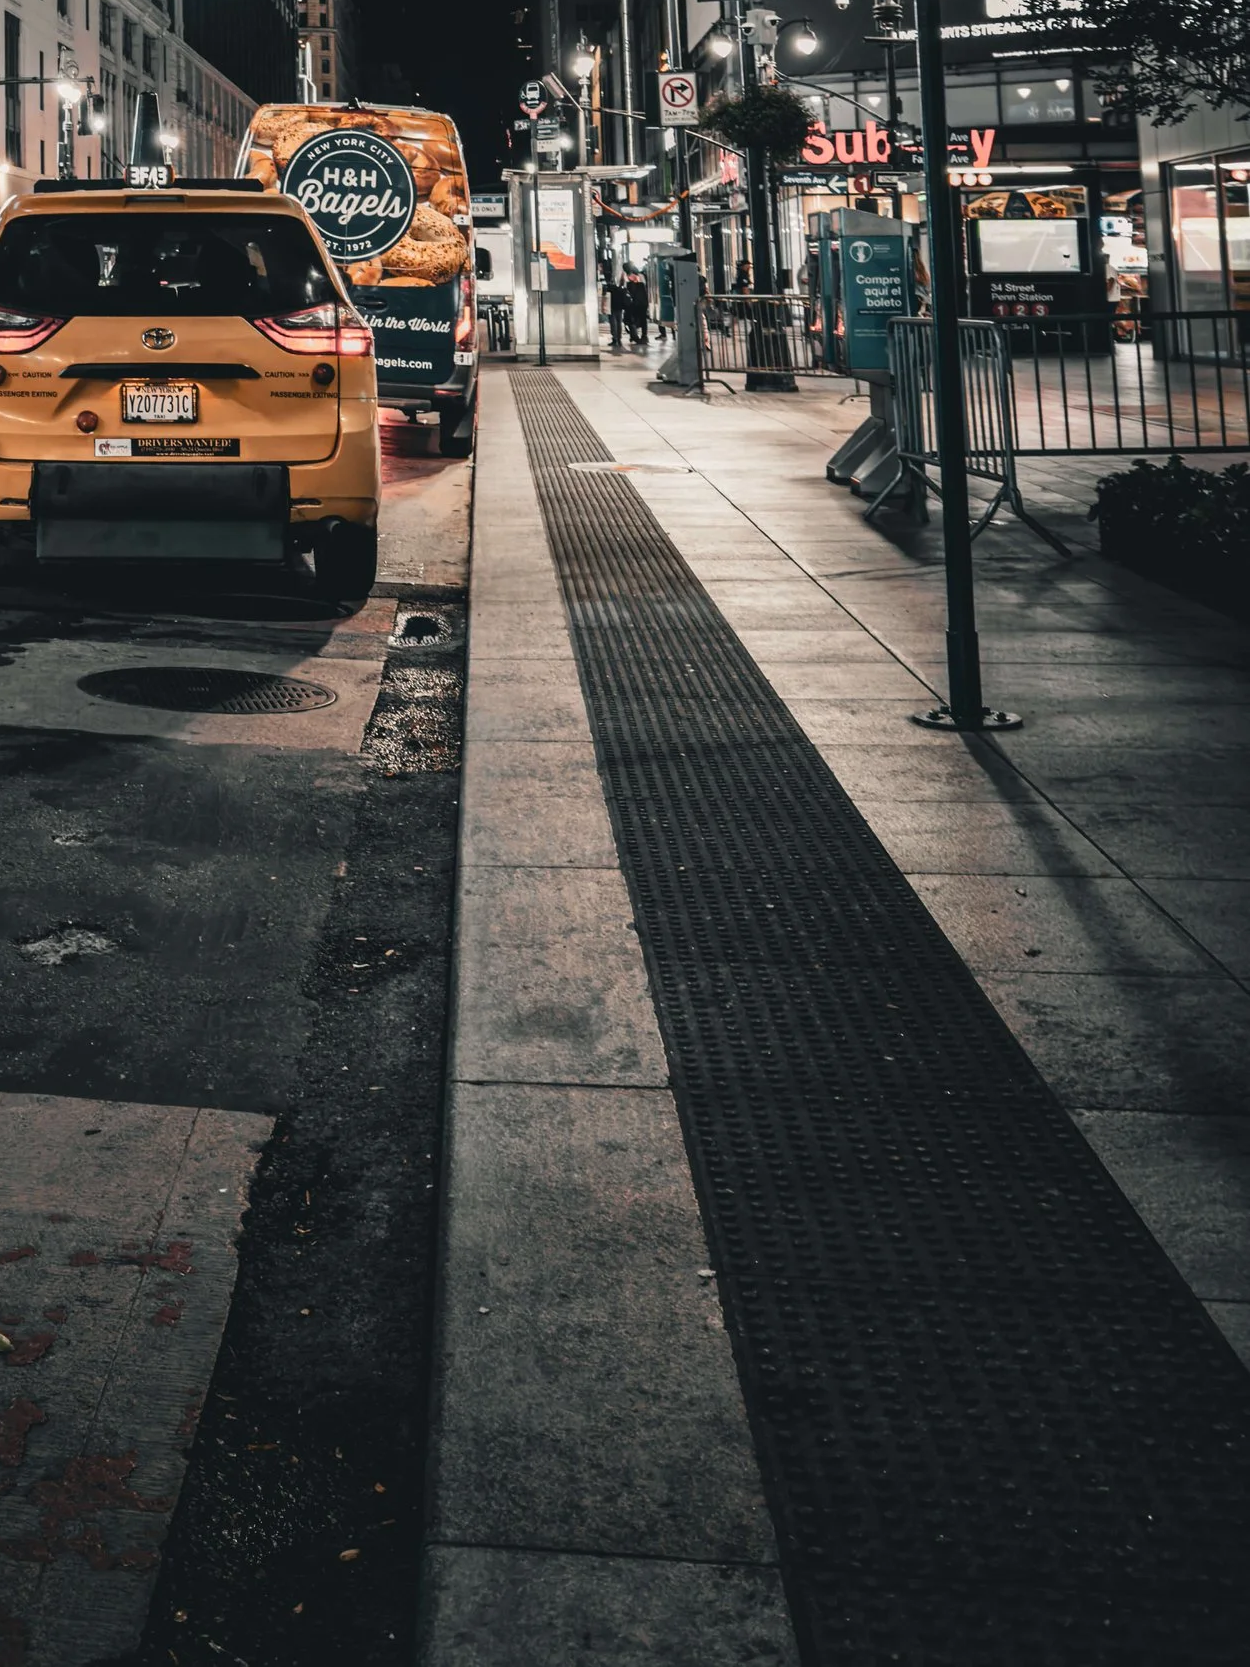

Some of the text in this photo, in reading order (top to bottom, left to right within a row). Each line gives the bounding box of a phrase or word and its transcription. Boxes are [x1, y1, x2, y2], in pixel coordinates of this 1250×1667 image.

[802, 118, 995, 168] Suby
[950, 133, 969, 142] Ave
[307, 138, 394, 165] NEW YORK CITY
[950, 154, 969, 163] Ave
[323, 167, 377, 188] H&H
[783, 175, 827, 184] Seventh Ave
[859, 178, 868, 191] 1
[297, 178, 408, 225] Bagels
[347, 240, 372, 251] 1972
[855, 275, 901, 286] Compre
[891, 286, 902, 295] el
[991, 283, 1035, 292] 34 Street
[991, 292, 1054, 301] Penn Station
[866, 298, 902, 307] boleto
[998, 304, 1045, 316] 1 2 3
[370, 315, 450, 333] in the World
[129, 394, 189, 413] Y207731C
[138, 439, 231, 447] DRIVERS WANTED!
